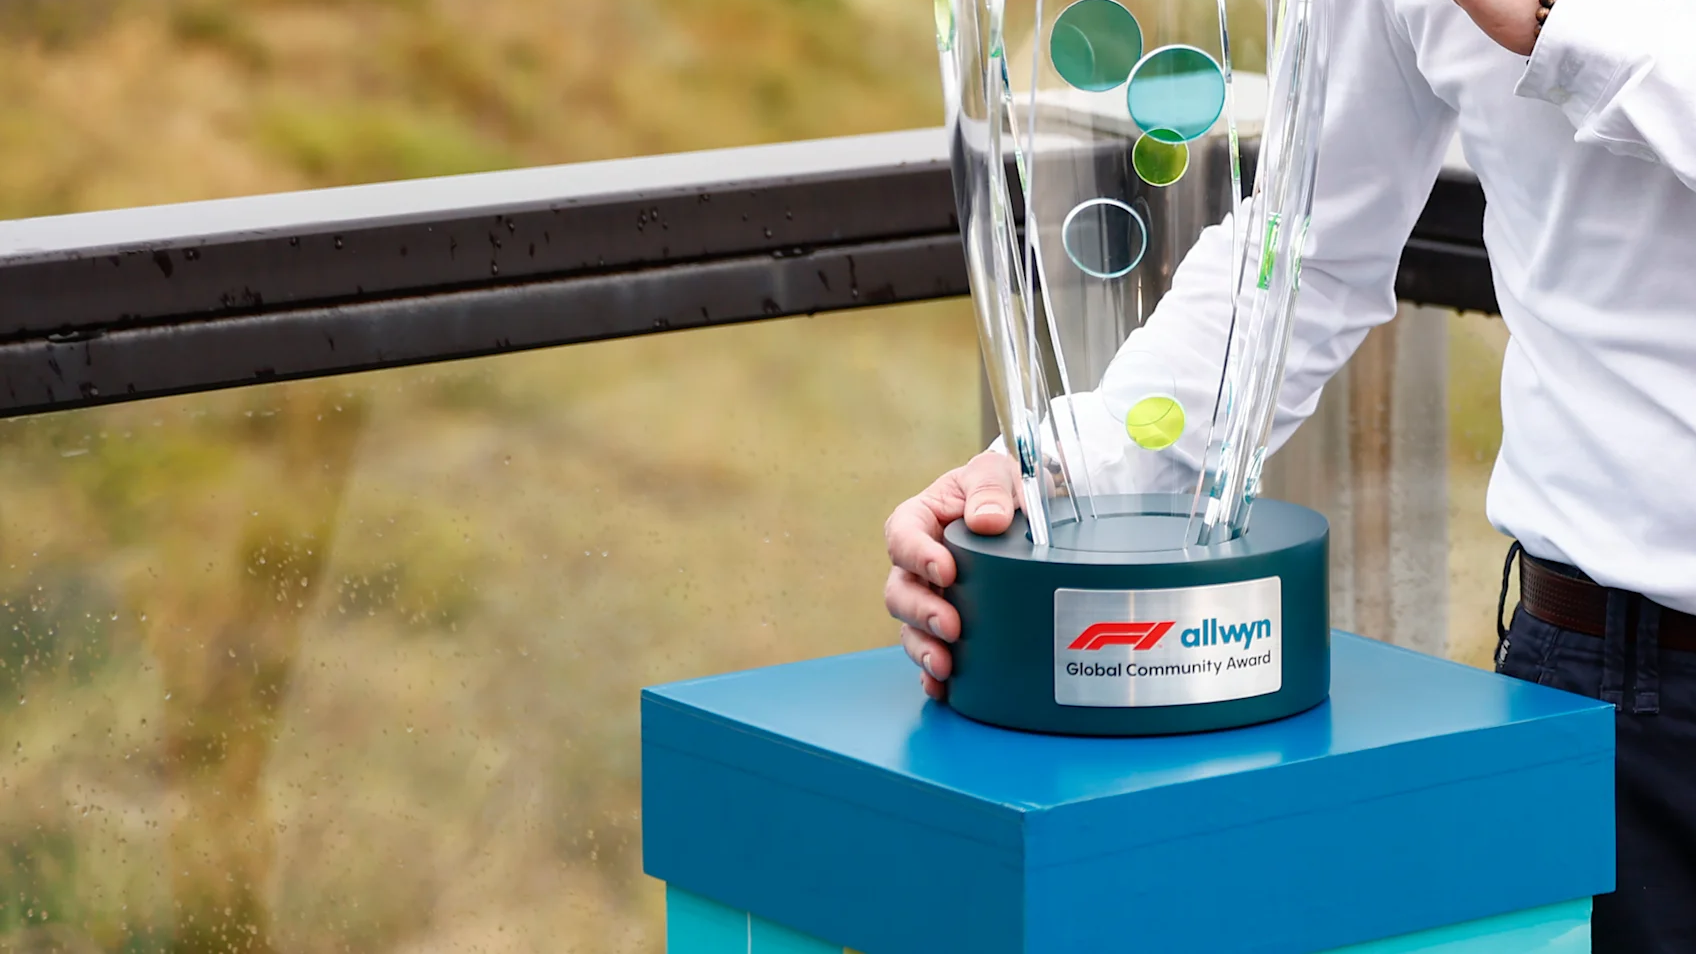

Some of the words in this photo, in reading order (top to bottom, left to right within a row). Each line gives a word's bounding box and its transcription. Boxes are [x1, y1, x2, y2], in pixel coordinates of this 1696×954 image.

[1180, 618, 1271, 650] allwyn
[1066, 662, 1122, 677] Global
[1126, 660, 1222, 677] Community
[1226, 650, 1271, 671] Award
